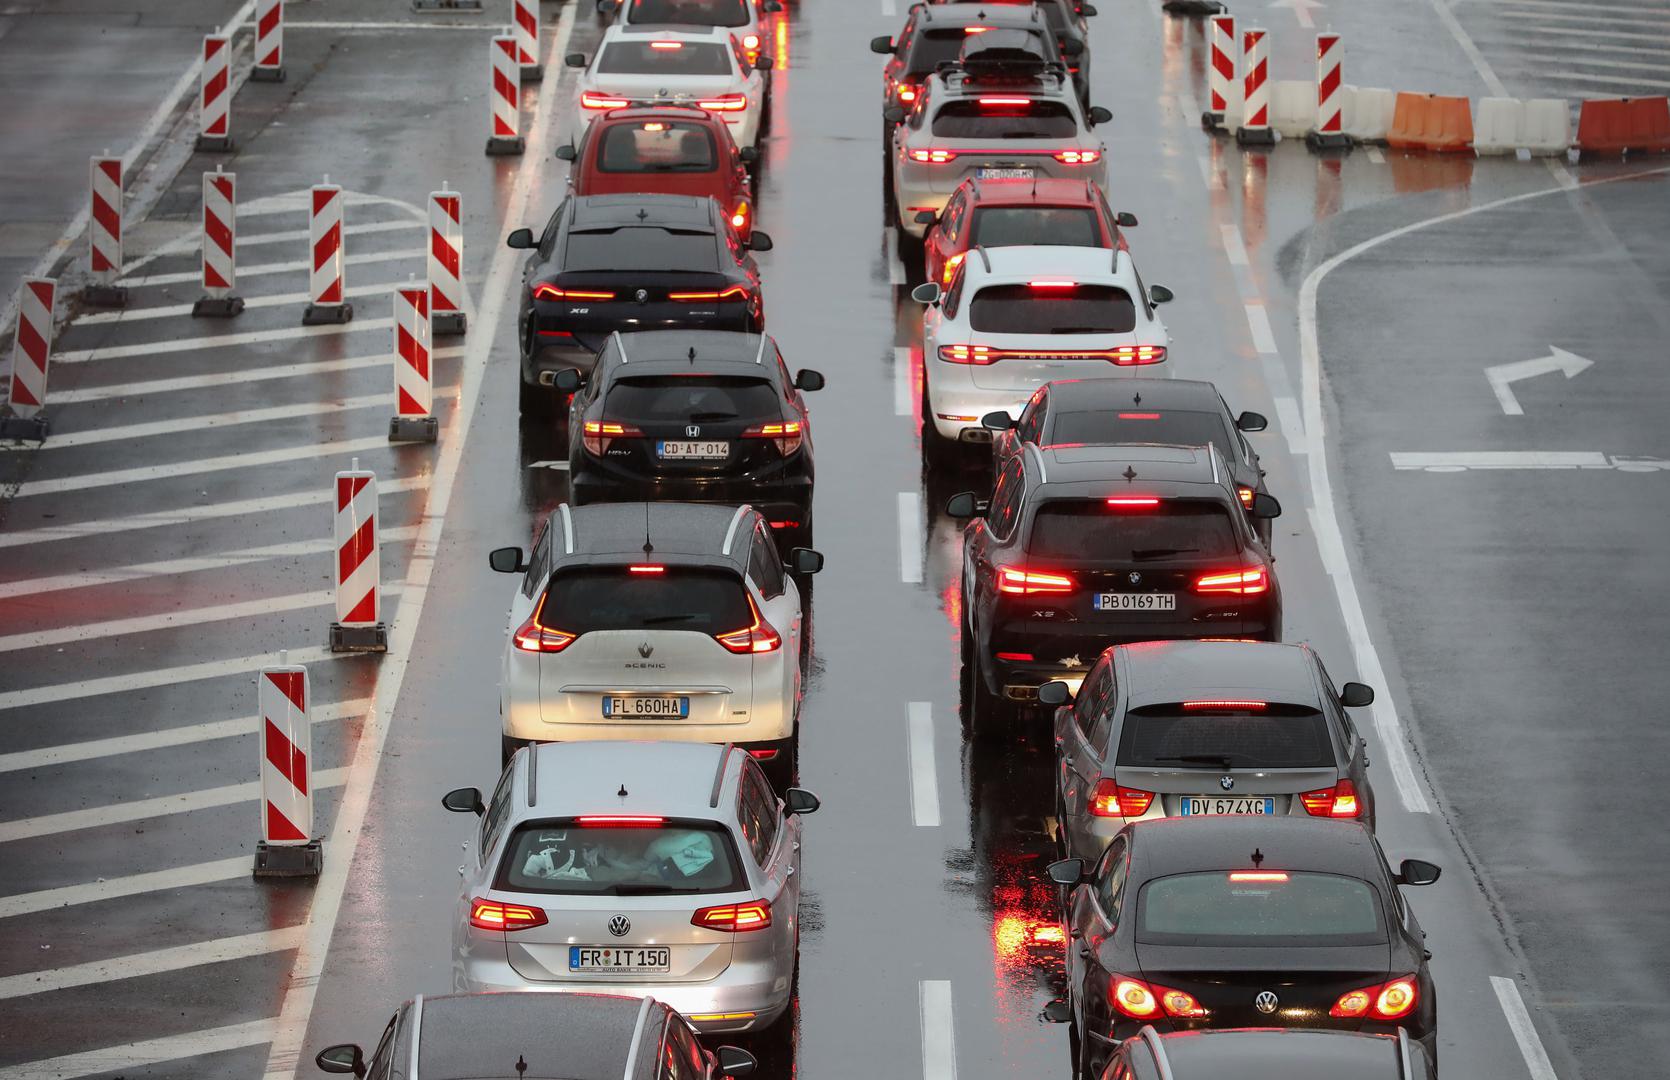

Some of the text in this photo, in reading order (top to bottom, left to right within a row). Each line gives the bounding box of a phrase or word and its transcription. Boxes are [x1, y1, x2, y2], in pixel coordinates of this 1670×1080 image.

[1102, 595, 1174, 609] PB 0169 TH
[613, 699, 629, 713] FL
[636, 699, 679, 713] 660HA
[1192, 800, 1210, 815] DV
[1216, 800, 1263, 815] 674XG
[580, 950, 601, 966] FR
[614, 950, 634, 966] IT
[637, 950, 668, 966] 150
